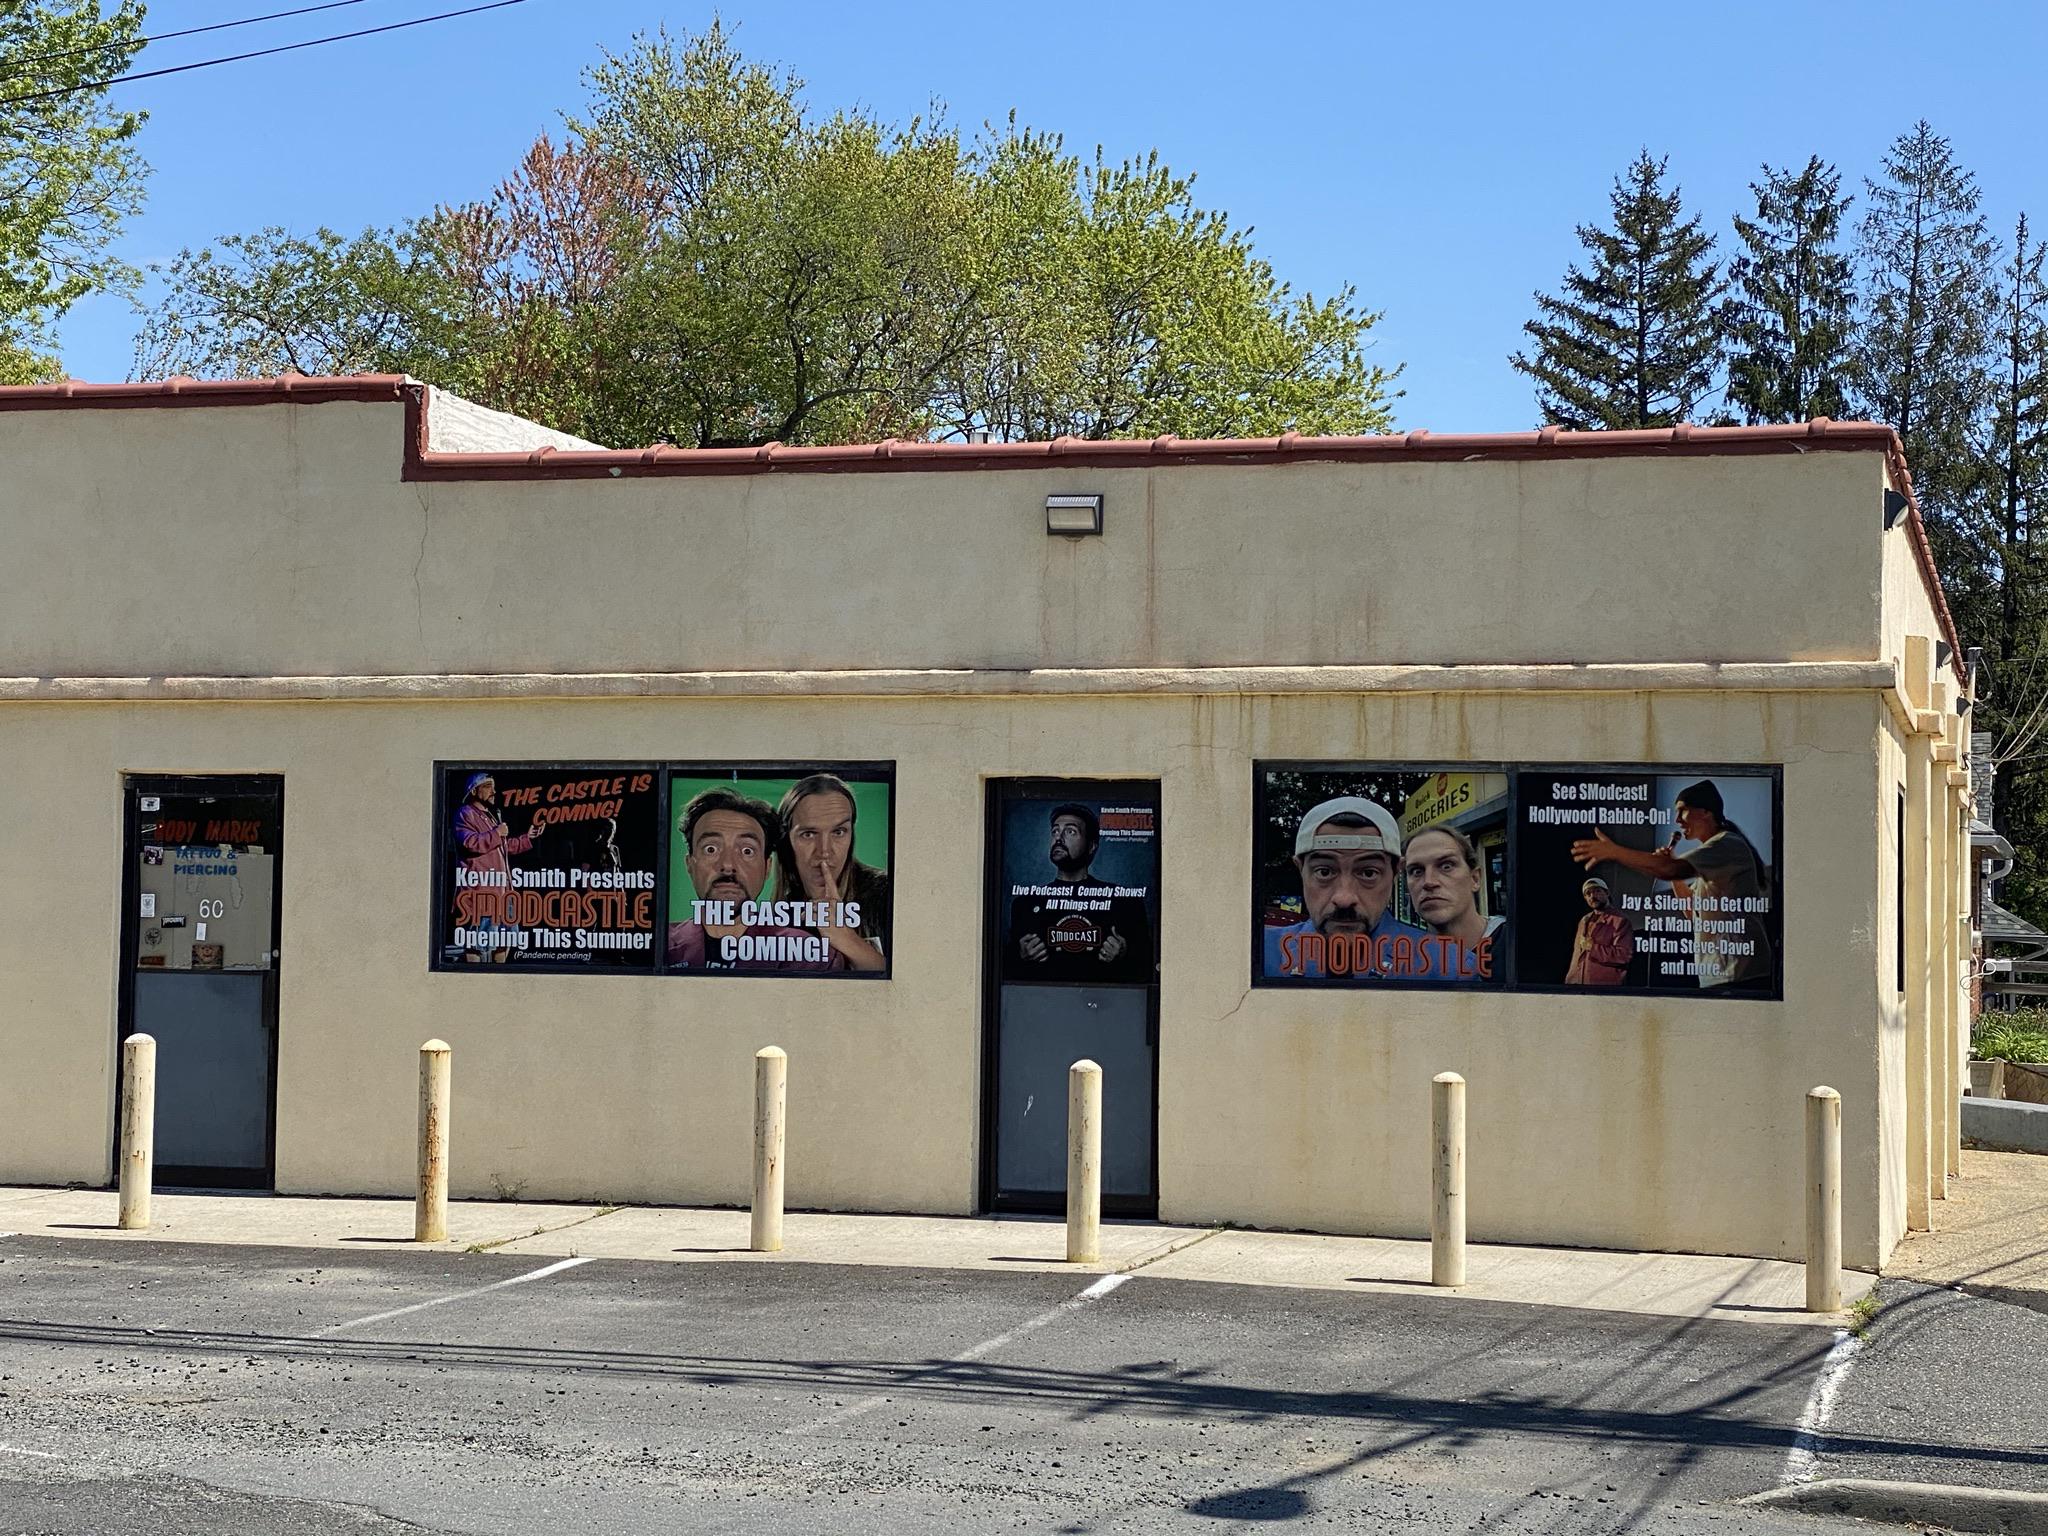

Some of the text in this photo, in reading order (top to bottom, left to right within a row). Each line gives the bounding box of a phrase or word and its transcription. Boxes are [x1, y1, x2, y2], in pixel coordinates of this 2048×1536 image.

[502, 773, 653, 808] THE CASTLE IS
[1552, 782, 1648, 801] See SModcast!
[532, 799, 624, 826] COMING!
[1406, 782, 1470, 833] GROCERIES
[1529, 806, 1671, 825] Hollywood Babble-On!
[154, 818, 263, 842] BODY MARKS
[175, 847, 237, 859] TATTOO &
[173, 864, 237, 876] PIERCING
[455, 867, 655, 889] Kevin Smith Presents
[1011, 885, 1147, 898] Live Podcasts! Comedy Shows!
[199, 898, 224, 919] 60
[455, 890, 653, 928] SMODCASTLE
[1045, 899, 1112, 911] All Things Oral!
[1621, 894, 1769, 913] Jay & Silent Bob Get Old!
[690, 900, 861, 928] THE CASTLE IS
[1644, 916, 1745, 934] Fat Man Beyond!
[454, 928, 653, 950] Opening This Summer
[1635, 937, 1755, 956] Tell Em Steve-Dave!
[513, 950, 592, 961] (Pandemic pending)
[720, 936, 830, 963] COMING!
[1280, 933, 1493, 978] SMODCASTLE
[1660, 960, 1685, 975] and
